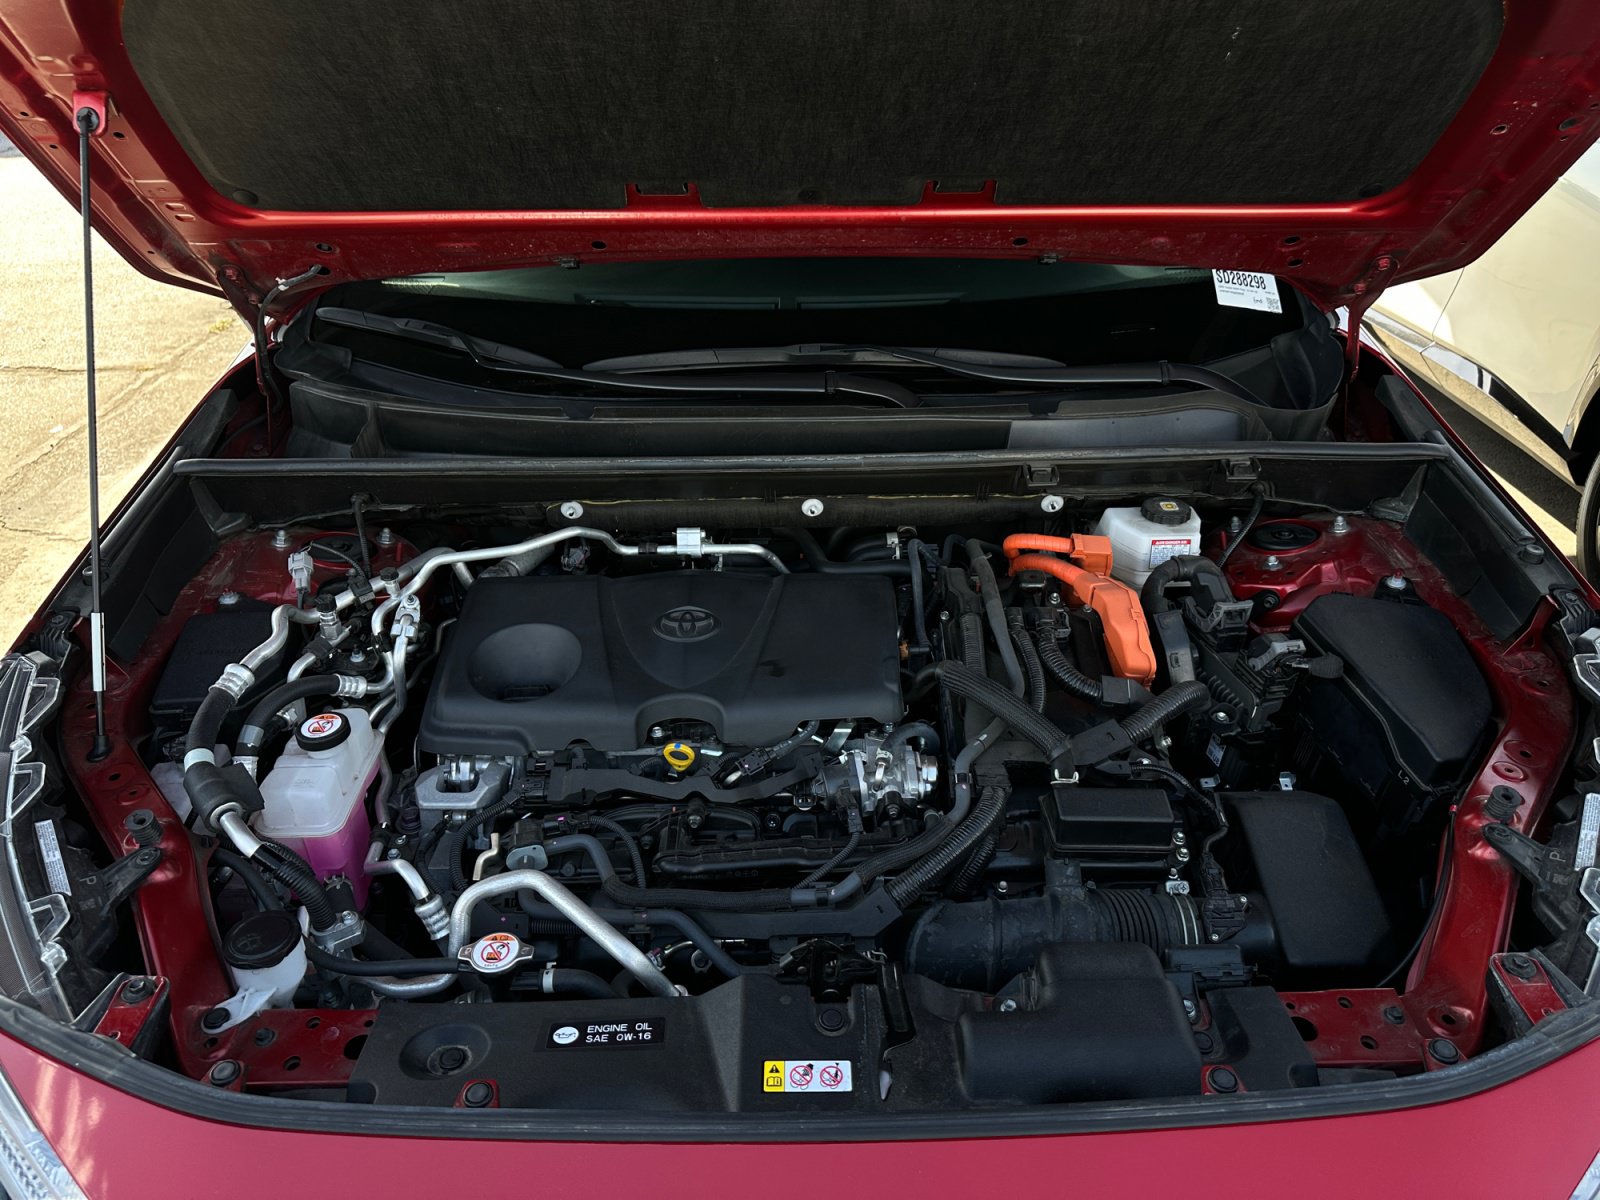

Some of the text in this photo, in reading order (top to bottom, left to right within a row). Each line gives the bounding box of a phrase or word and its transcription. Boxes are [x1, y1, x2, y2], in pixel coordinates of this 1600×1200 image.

[1215, 270, 1267, 290] SD288298
[587, 1022, 653, 1033] ENGINE OIL
[585, 1031, 652, 1043] SAE 0W-16
